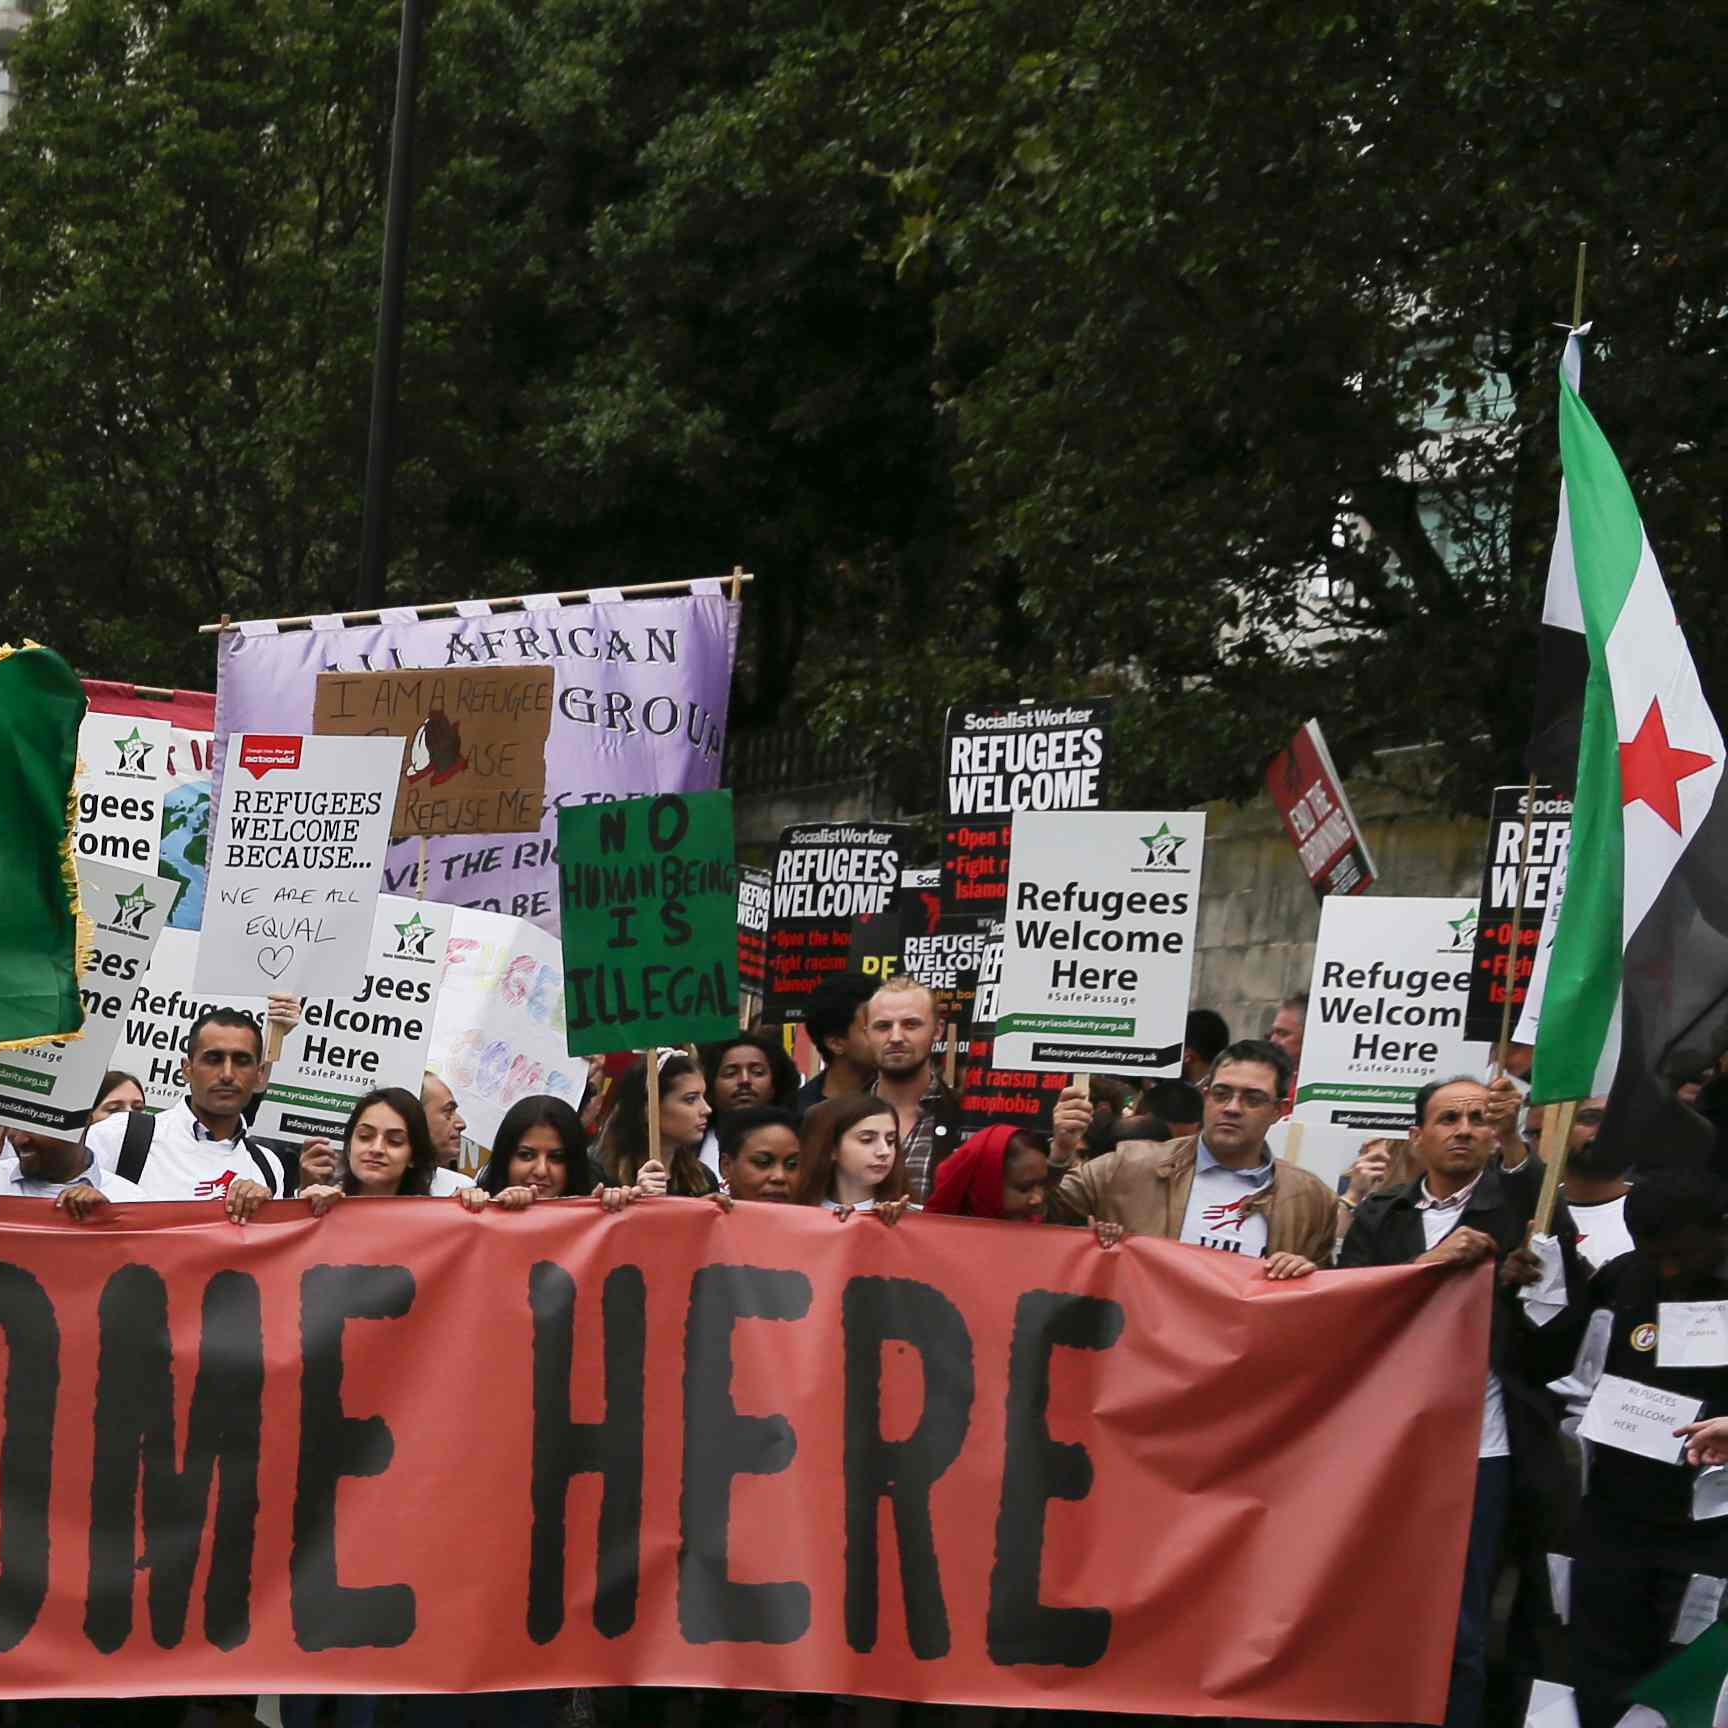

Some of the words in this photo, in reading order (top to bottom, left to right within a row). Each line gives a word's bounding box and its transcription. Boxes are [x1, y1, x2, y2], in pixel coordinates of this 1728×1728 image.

[446, 626, 678, 666] AFRICAN
[328, 679, 362, 719] I
[455, 677, 548, 714] REFUGEE
[950, 728, 1104, 777] REFUGEES
[232, 790, 383, 816] REFUGEES
[497, 786, 536, 827] ME
[948, 768, 1100, 815] WELCOME
[230, 817, 361, 842] WELCOME
[957, 827, 999, 853] Open
[224, 844, 373, 870] BECAUSE...
[441, 846, 504, 882] THE
[775, 848, 899, 885] REFUGEES
[956, 858, 995, 882] Fight
[221, 887, 260, 905] WE
[273, 886, 318, 904] ARE
[1015, 881, 1190, 922] Refugees
[246, 915, 337, 943] EQUAL
[1014, 920, 1185, 955] Welcome
[904, 935, 986, 955] REFUGE
[1051, 960, 1140, 992] Here
[1320, 961, 1472, 998] Refugee
[568, 961, 741, 1031] ILLEGAL
[1047, 991, 1137, 1006] #SafePassage
[1012, 1015, 1131, 1034] www.syriasolidarity.org.uk
[1319, 997, 1462, 1028] Welcom
[126, 1019, 191, 1054] Welc
[1352, 1033, 1440, 1063] Here
[301, 1034, 381, 1073] Here
[1038, 1046, 1159, 1064] info@syriasolidarity.org.uk
[297, 1066, 377, 1089] #SafePassage
[1347, 1065, 1436, 1076] #SafePassage
[526, 1257, 1126, 1670] HERE
